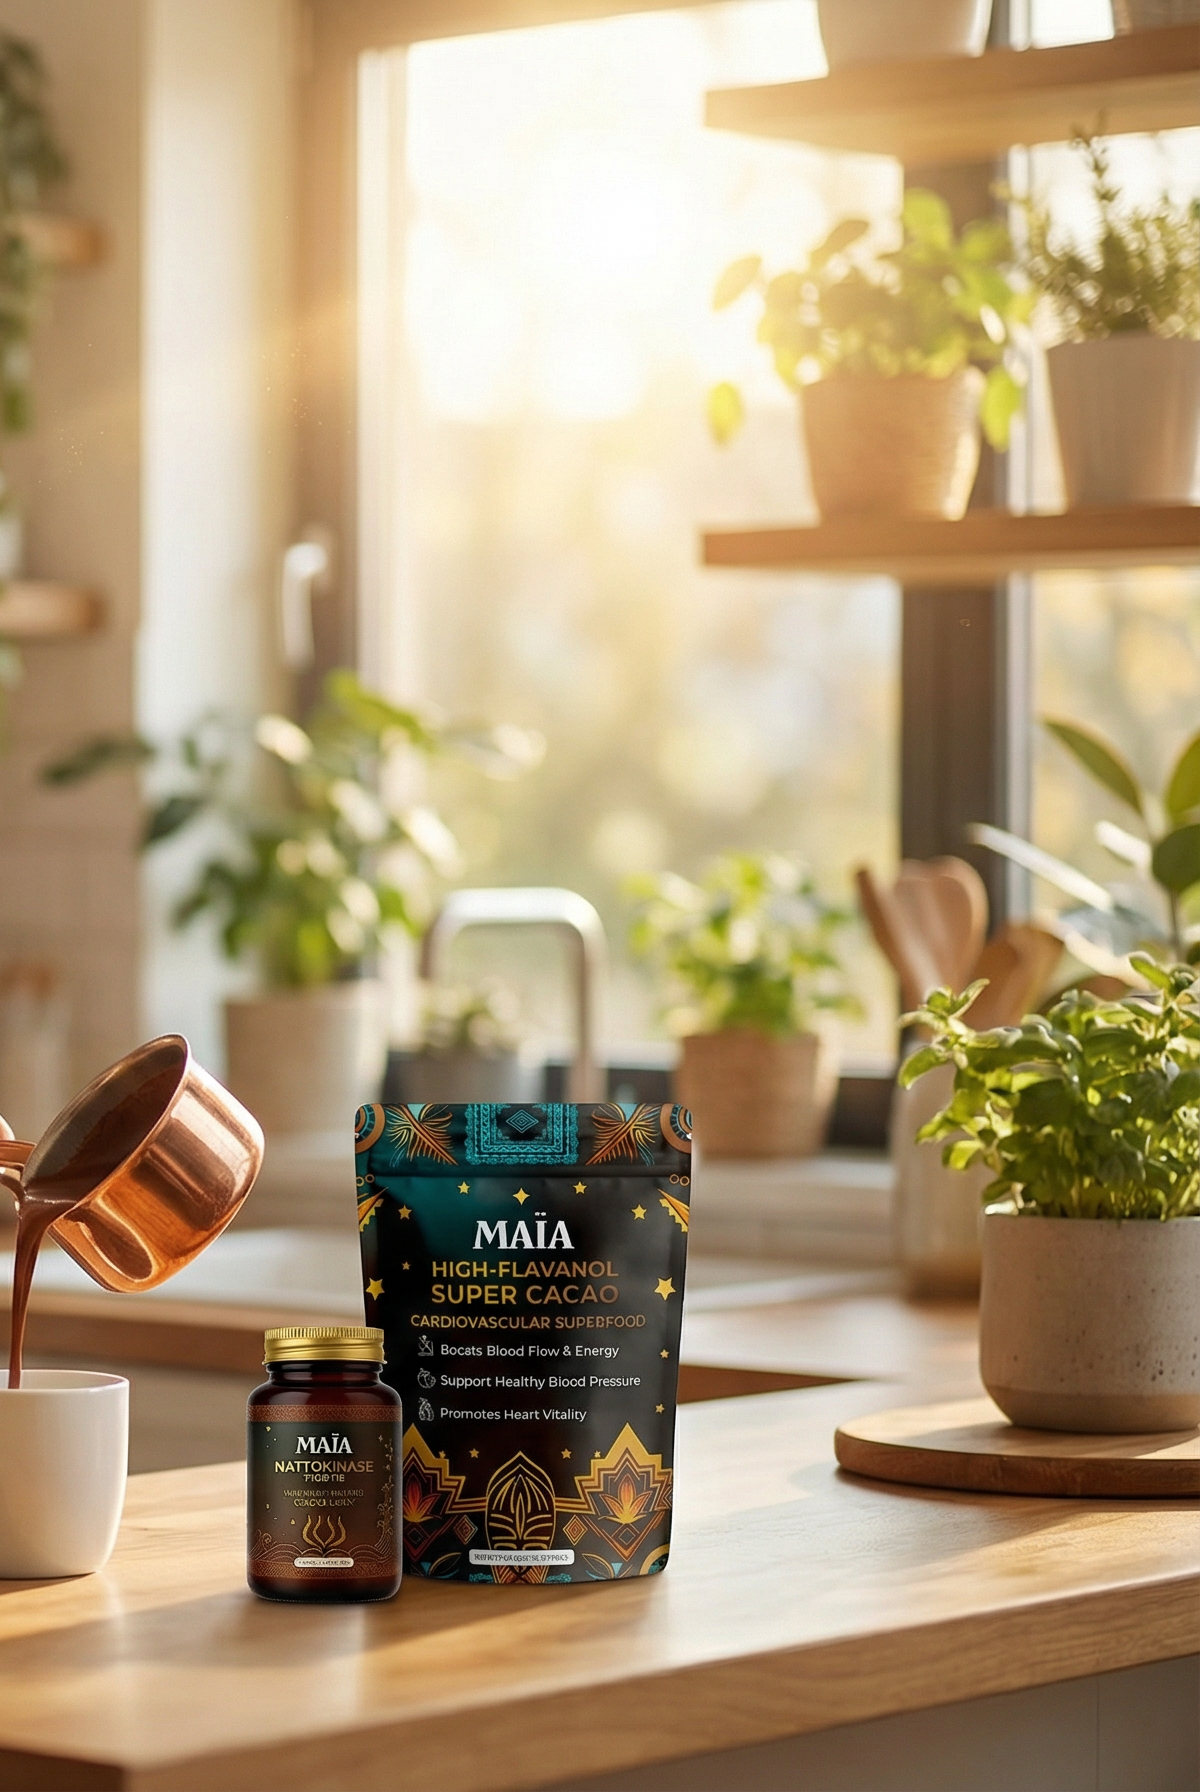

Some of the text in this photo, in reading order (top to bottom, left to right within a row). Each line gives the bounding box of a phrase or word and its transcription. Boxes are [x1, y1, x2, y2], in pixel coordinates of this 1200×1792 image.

[432, 1260, 619, 1278] HIGH-FLAVANOL
[431, 1283, 619, 1305] SUPER CACAO
[410, 1314, 550, 1329] CARDIOVASCULAR
[486, 1344, 525, 1357] Blood
[562, 1345, 572, 1357] &
[575, 1345, 620, 1359] Energy
[440, 1374, 492, 1389] Support
[495, 1375, 546, 1390] Healthy
[589, 1375, 641, 1387] Pressure
[440, 1407, 587, 1423] Promotes Heart Vitality
[274, 1460, 374, 1473] NATTOKINASE
